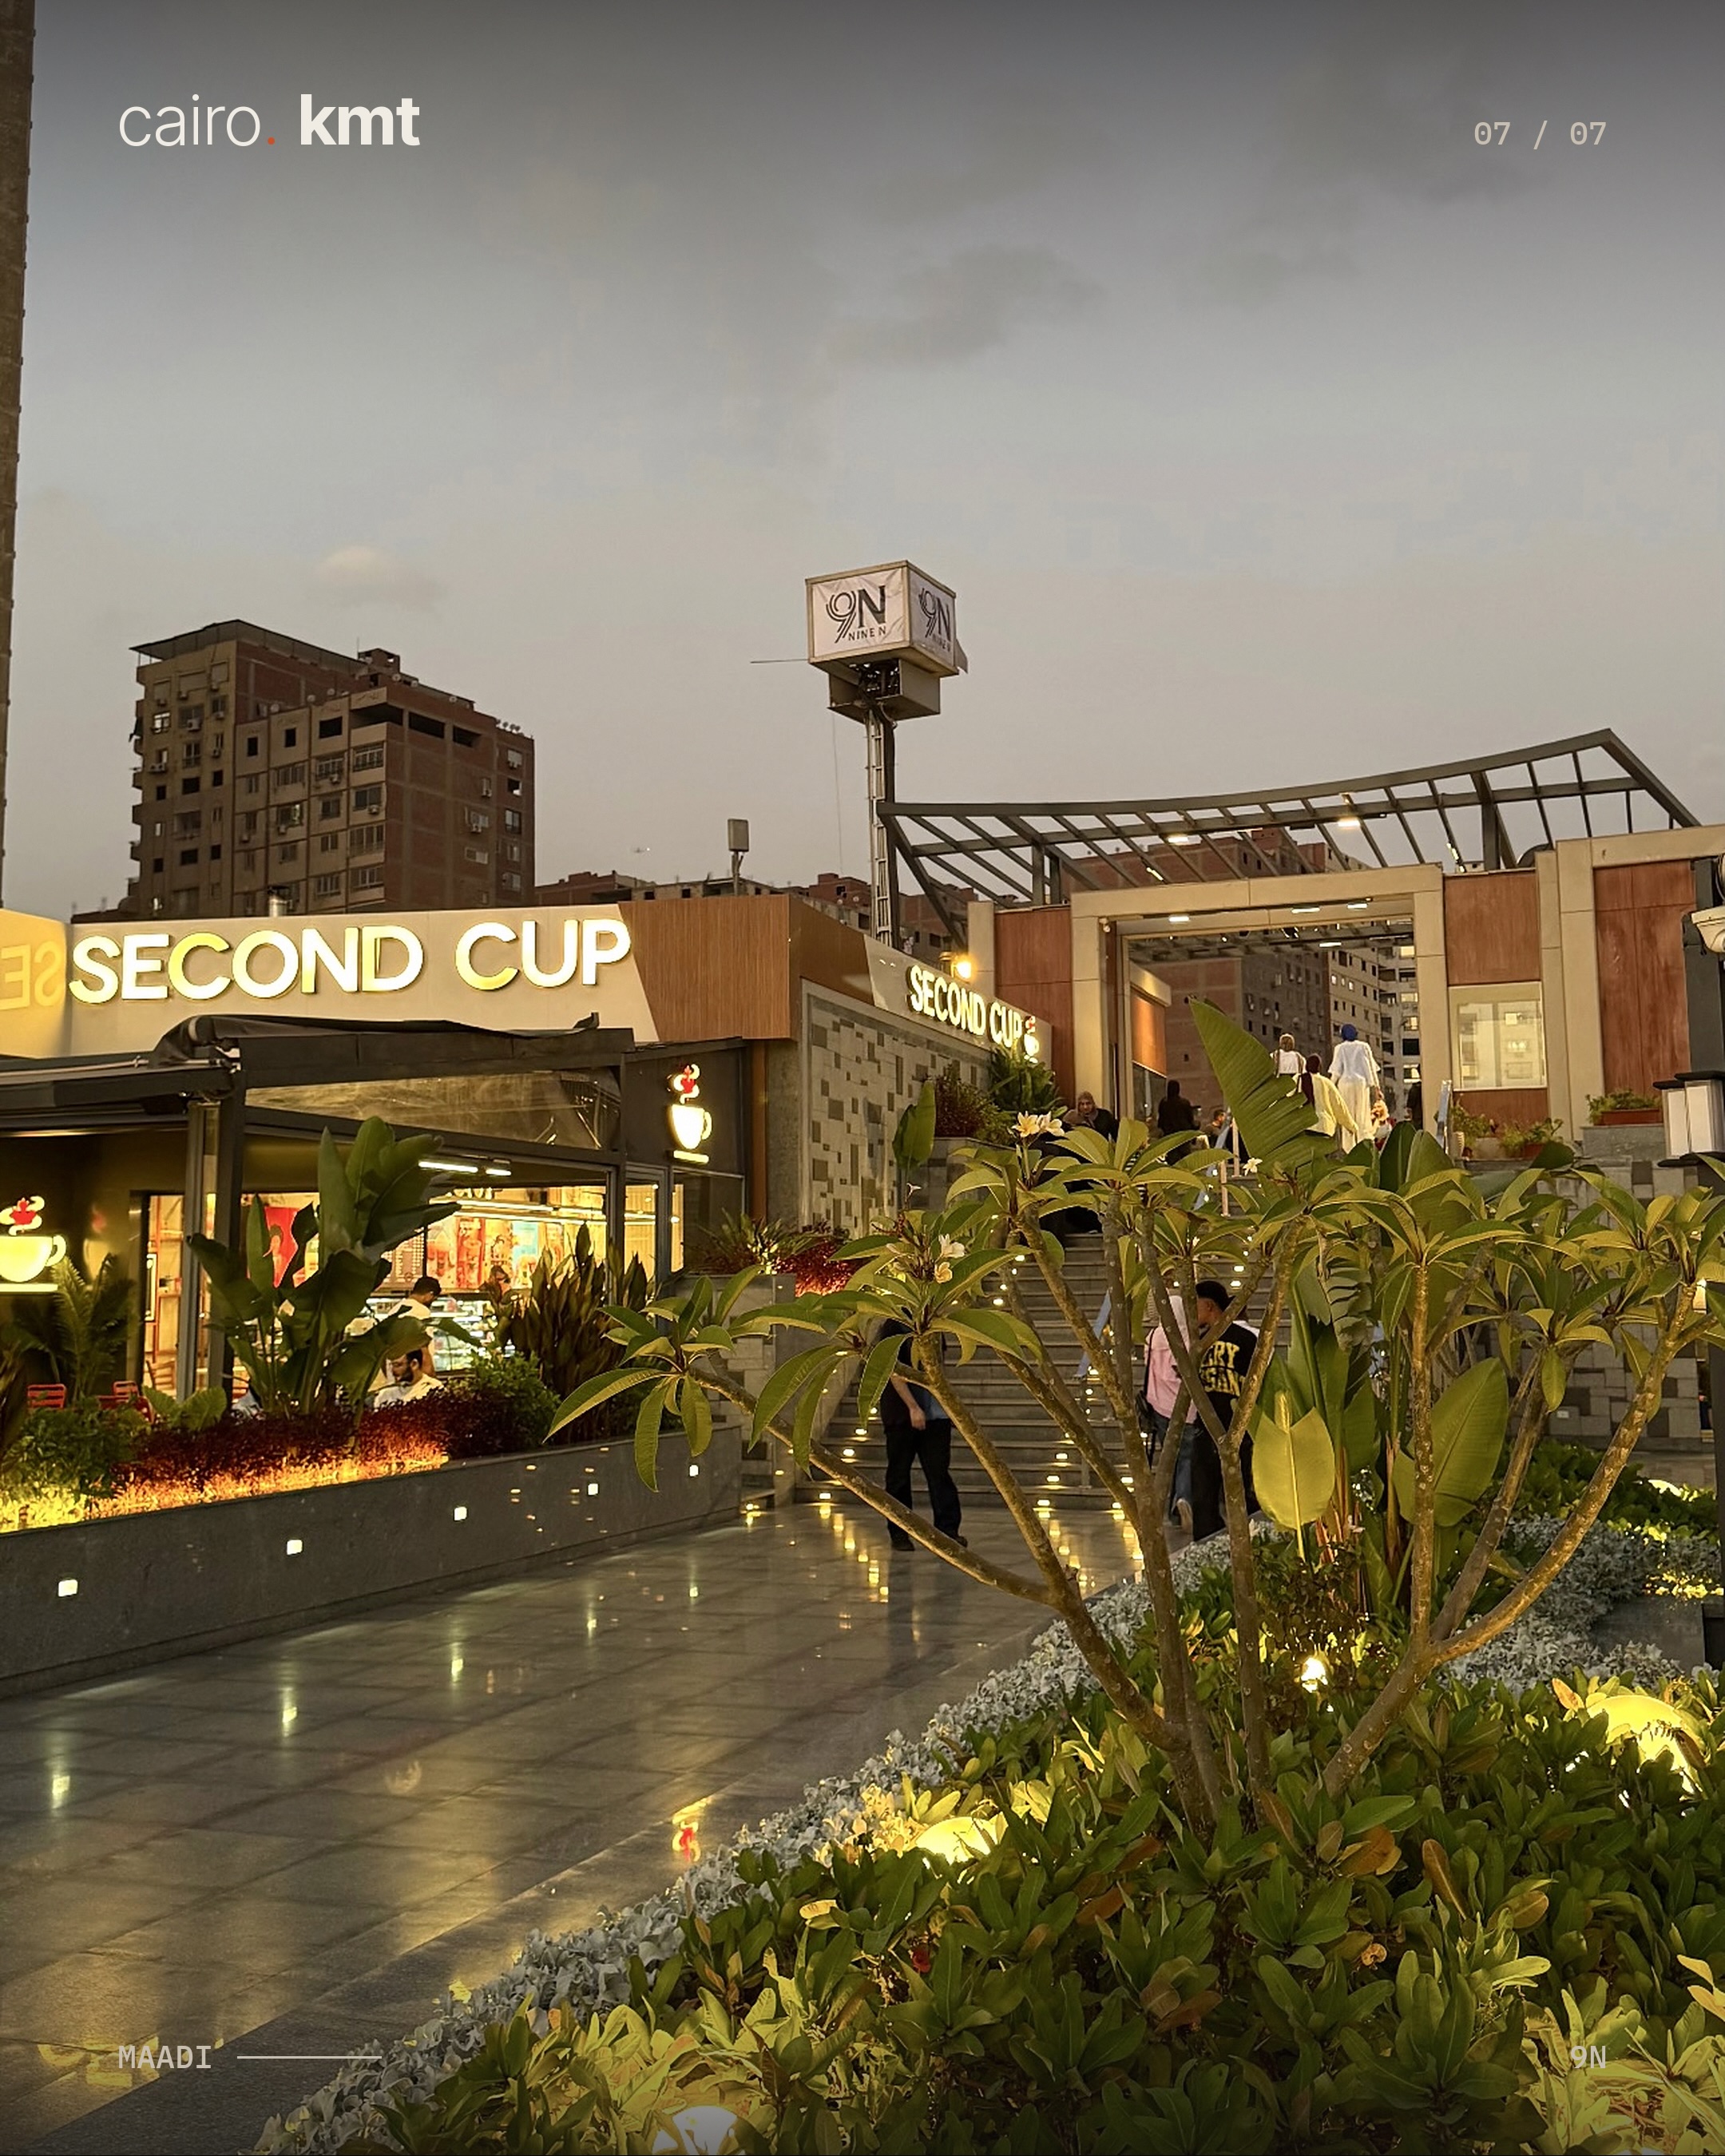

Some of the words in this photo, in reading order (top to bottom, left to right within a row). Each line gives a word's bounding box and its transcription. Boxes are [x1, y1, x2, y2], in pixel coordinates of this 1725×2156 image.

[826, 585, 886, 644] 9N
[848, 628, 875, 641] NINE
[878, 626, 886, 636] N
[918, 587, 951, 642] 9N
[69, 925, 425, 1004] SECOND
[456, 918, 632, 991] CUP
[908, 965, 986, 1036] SECOND
[989, 1001, 1023, 1048] CUP
